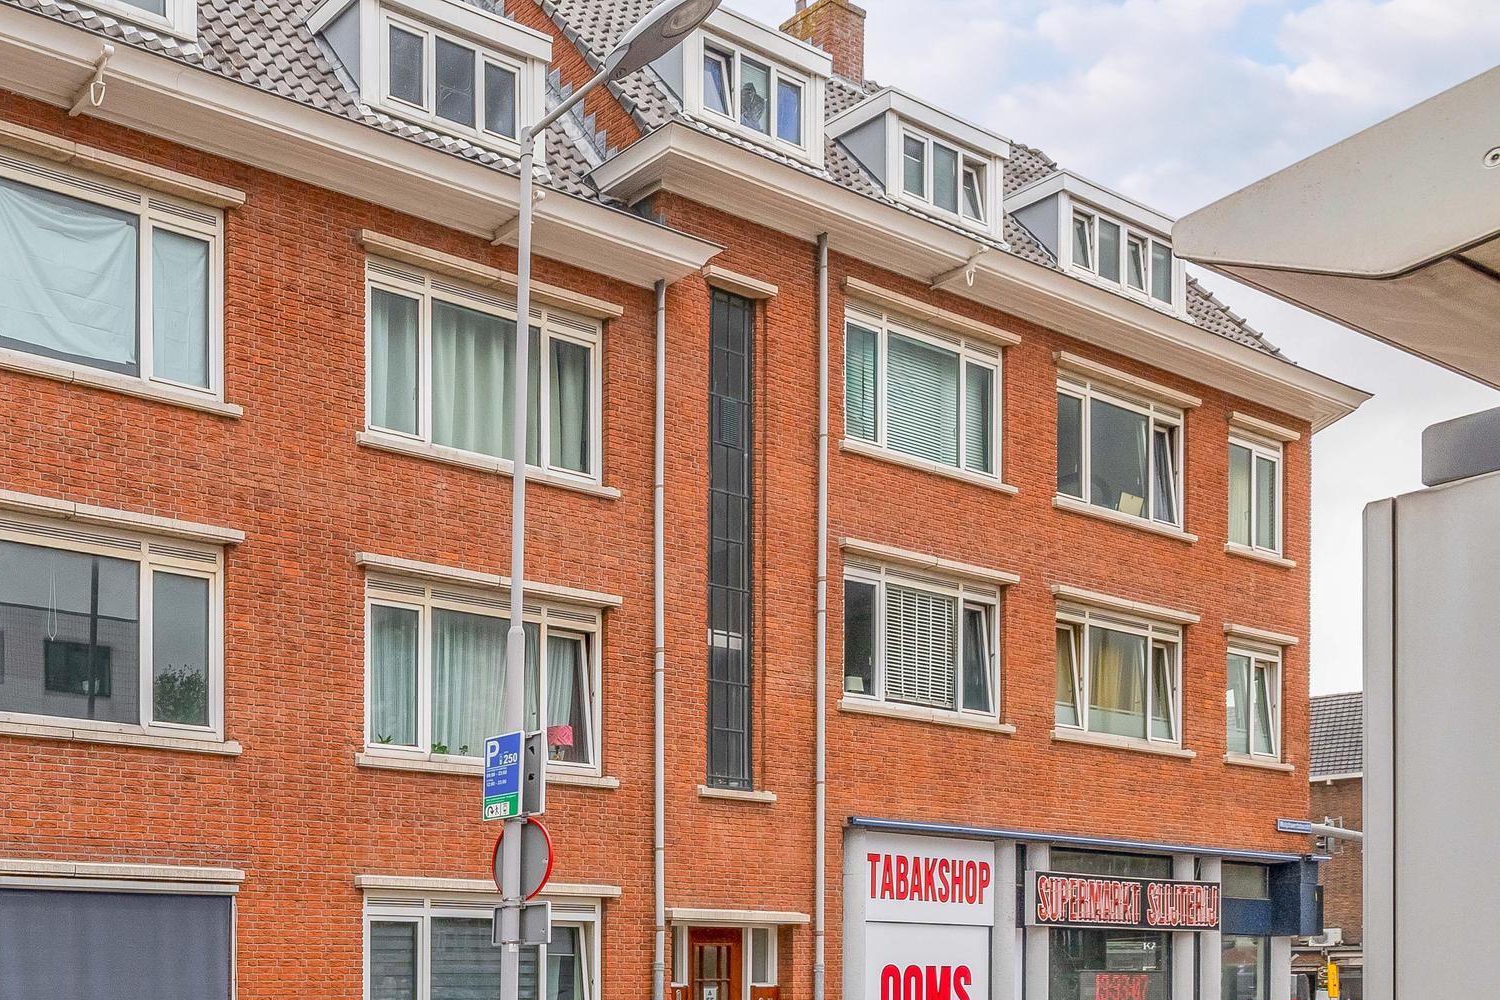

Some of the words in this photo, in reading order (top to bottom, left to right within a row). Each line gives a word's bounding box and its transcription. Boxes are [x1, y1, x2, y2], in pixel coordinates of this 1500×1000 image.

[487, 740, 500, 767] P
[503, 752, 518, 765] 250
[867, 852, 991, 905] TABAKSHOP
[1037, 875, 1143, 924] SUPERMARKT
[1146, 882, 1220, 928] SLIJTERIJ
